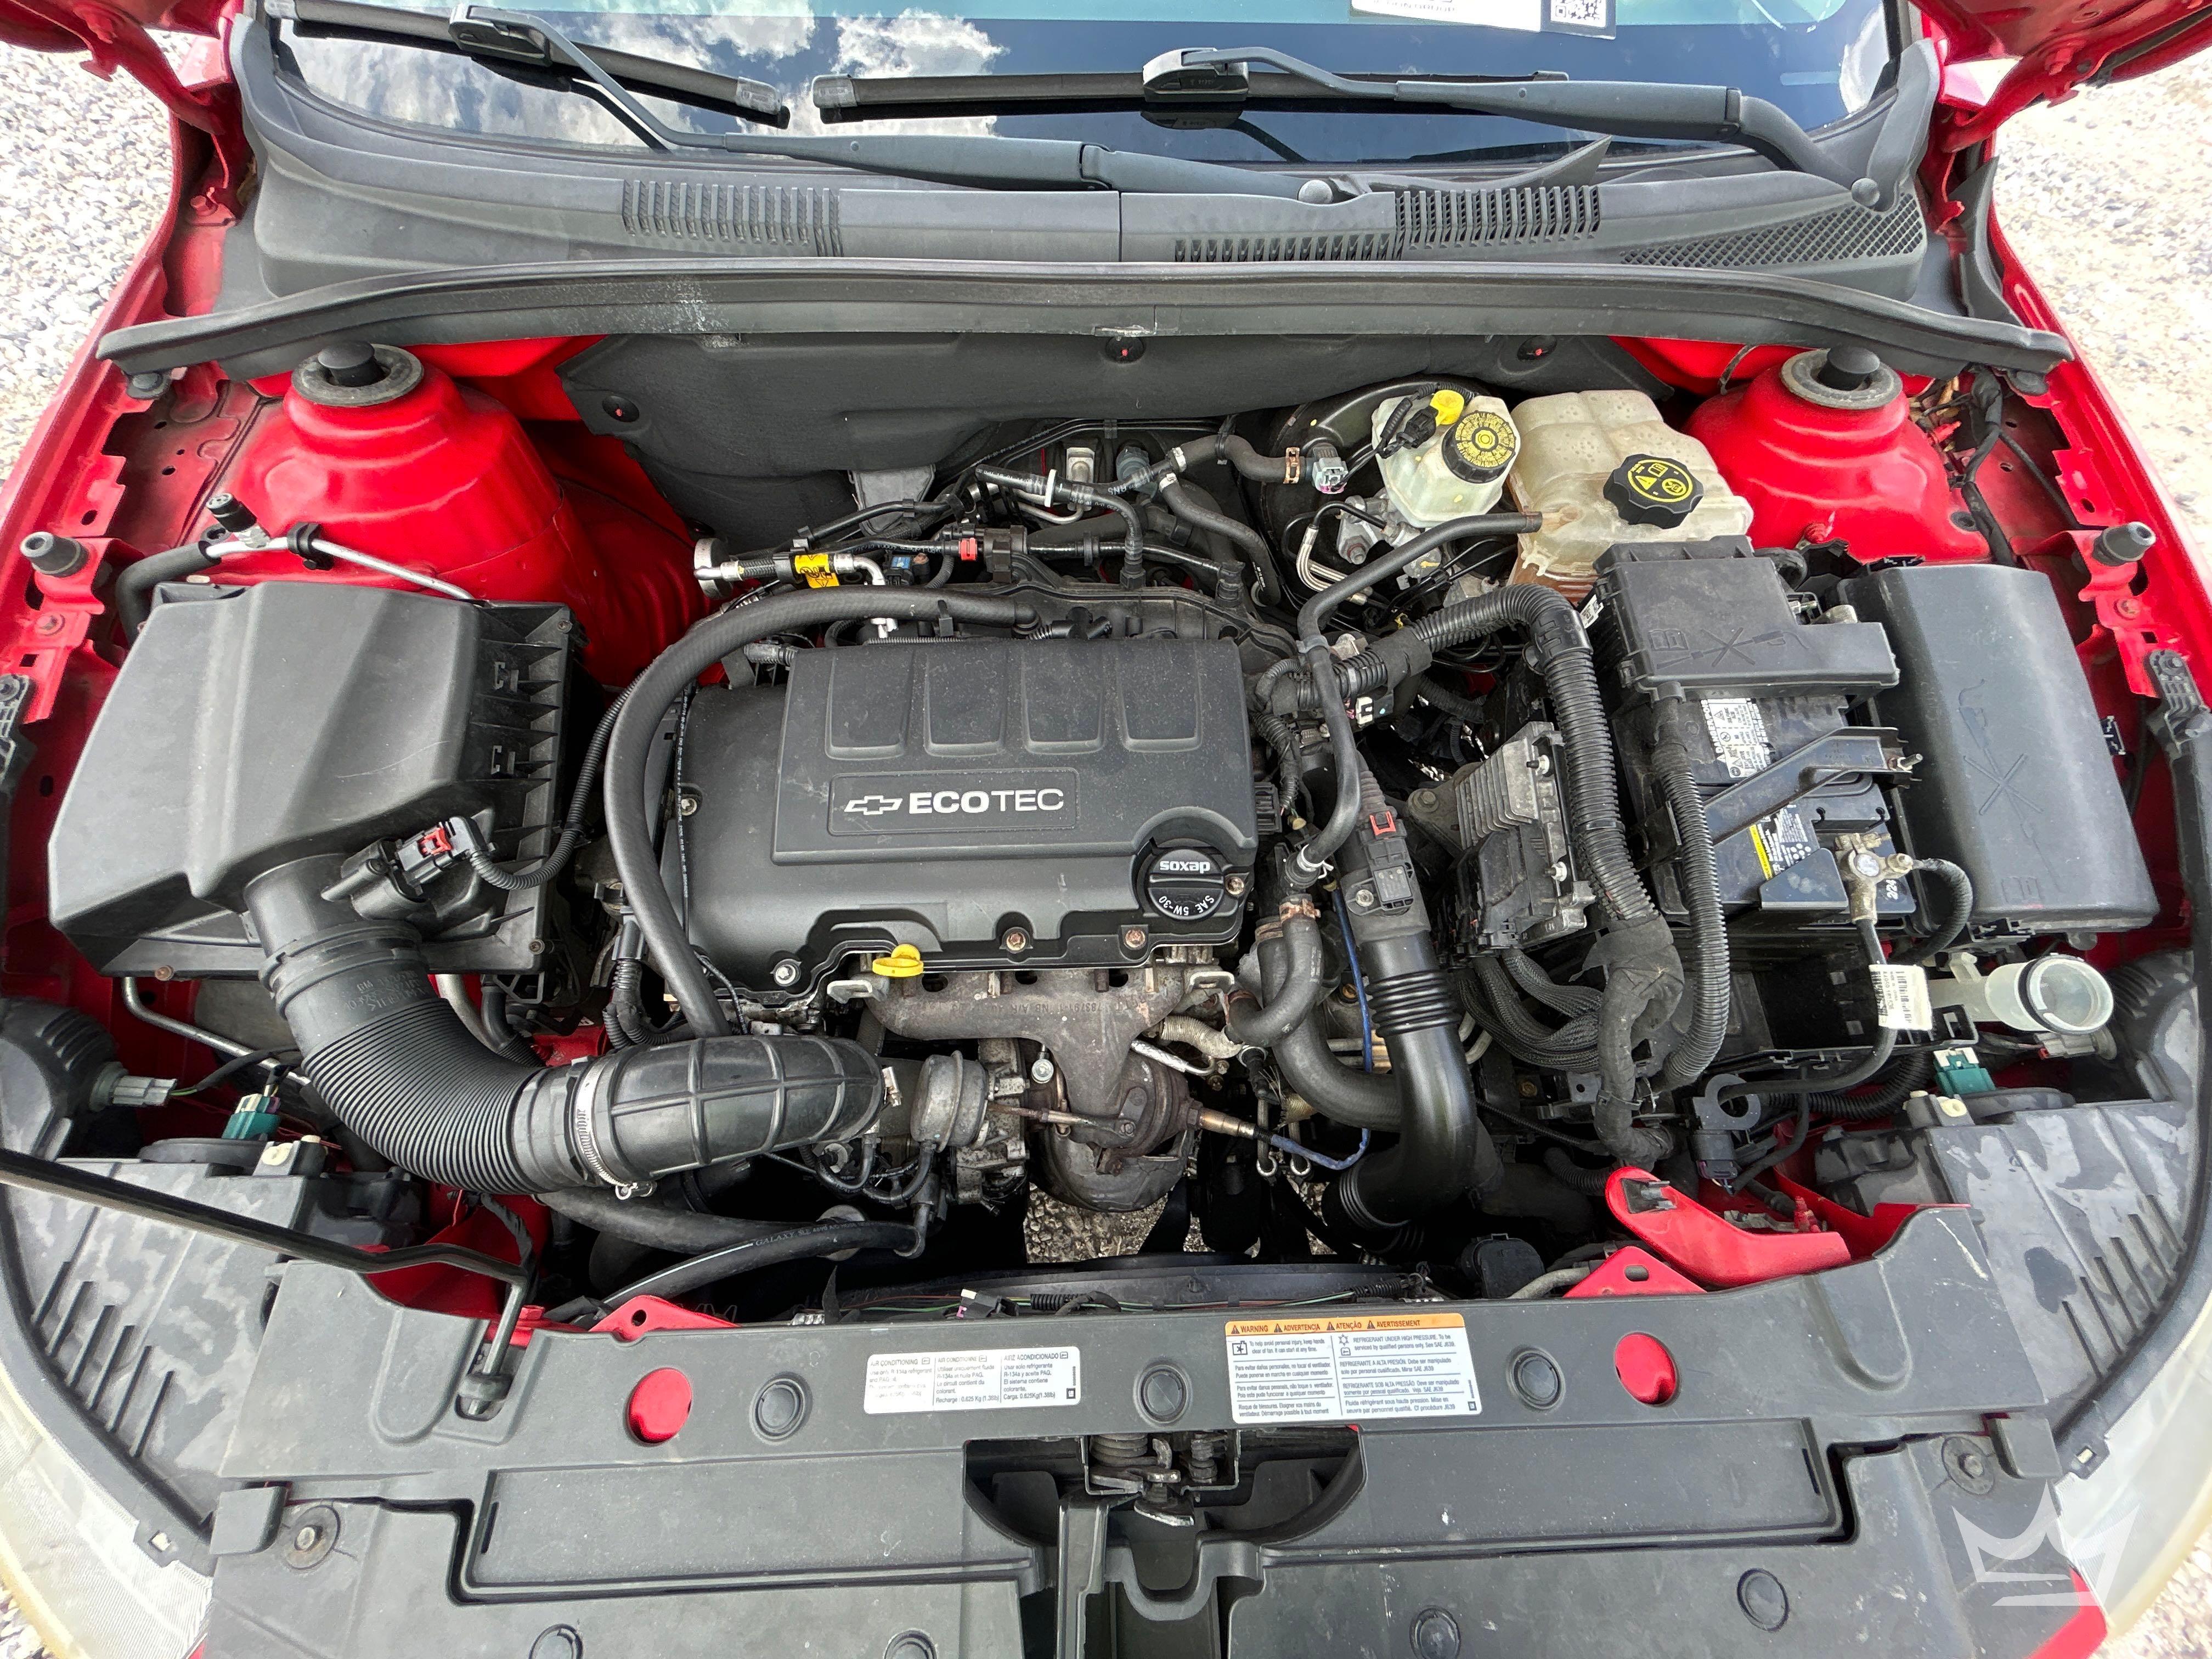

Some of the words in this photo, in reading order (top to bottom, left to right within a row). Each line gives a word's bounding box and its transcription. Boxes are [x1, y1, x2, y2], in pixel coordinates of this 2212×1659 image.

[1700, 699, 1724, 754] DANGER/POIS
[909, 788, 1064, 814] ECOTEC
[1159, 860, 1211, 874] dexos
[1159, 895, 1189, 916] 5W-30
[1195, 895, 1215, 913] SAE
[755, 1231, 795, 1246] GALAXY
[1336, 1321, 1362, 1330] ATENÇÃO
